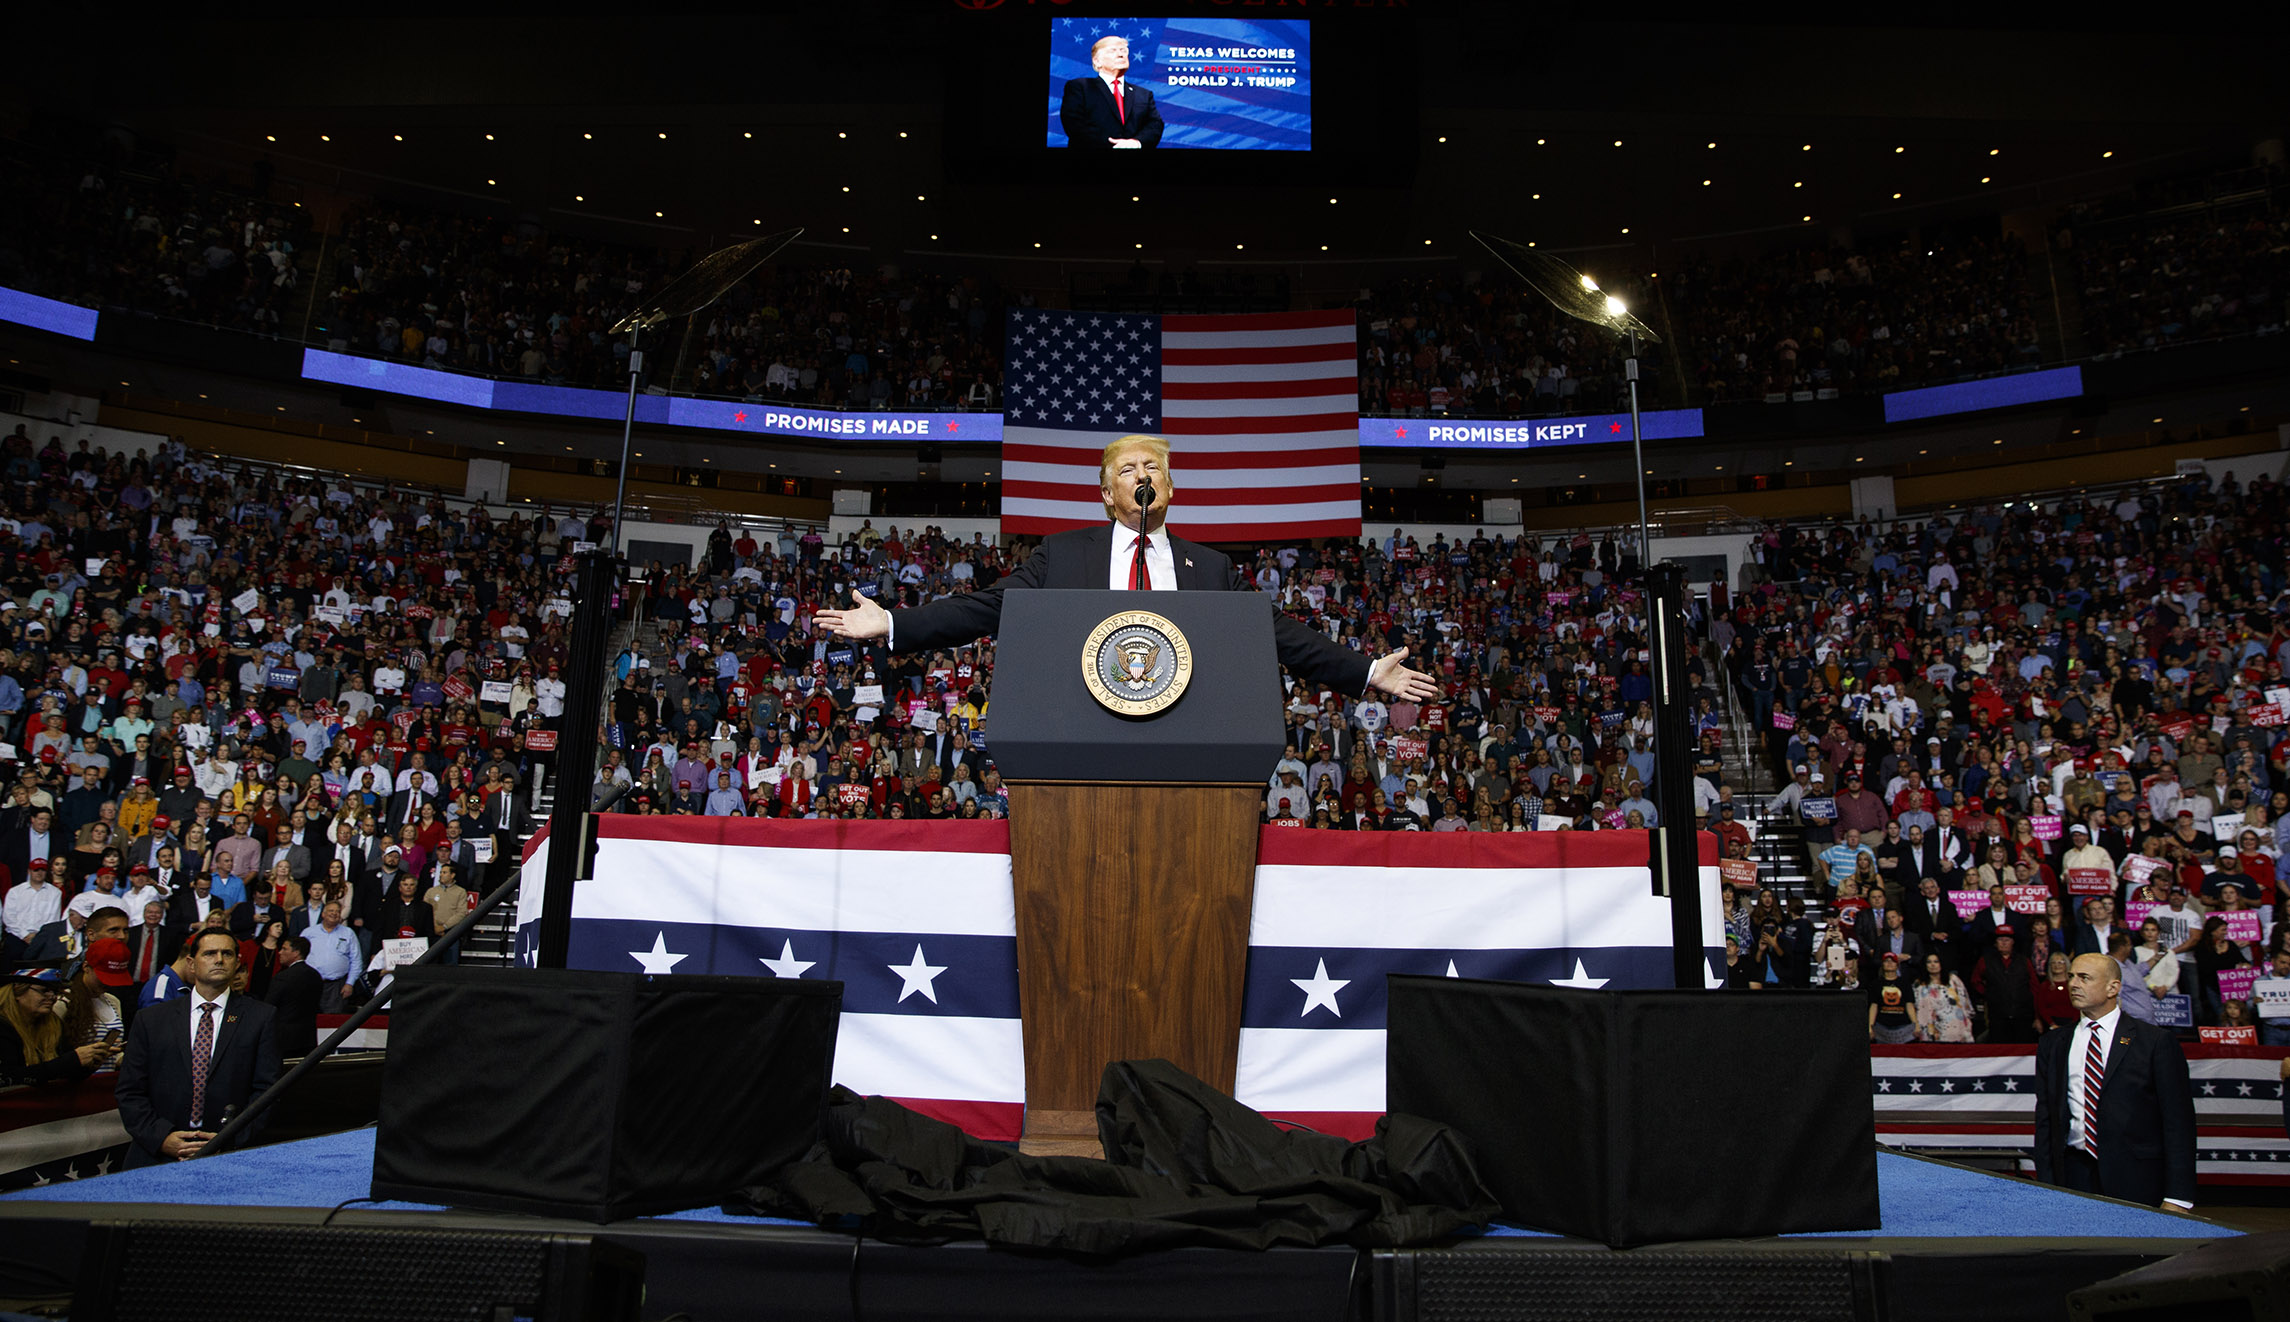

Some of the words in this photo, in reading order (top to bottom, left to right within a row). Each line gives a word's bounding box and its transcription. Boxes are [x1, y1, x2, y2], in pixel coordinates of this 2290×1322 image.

[1169, 47, 1213, 59] TEXAS
[1217, 47, 1295, 60] WELCOMES
[1204, 66, 1261, 74] PRESIDENT
[1168, 75, 1228, 87] DONALD
[1231, 76, 1243, 88] J.
[1247, 75, 1296, 88] TRUMP
[765, 413, 866, 434] PROMISES
[872, 419, 930, 435] MADE
[1429, 427, 1529, 443] PROMISES
[1536, 423, 1588, 441] KEPT
[1139, 615, 1150, 623] OF
[1151, 619, 1165, 629] THE
[1086, 614, 1137, 659] PRESIDENT
[1167, 628, 1189, 671] UNITED
[957, 664, 972, 677] 99
[1086, 662, 1094, 677] THE
[1098, 688, 1126, 710] SEAL
[1145, 679, 1183, 710] STATES
[2251, 714, 2281, 726] VOTE
[1399, 750, 1424, 758] VOTE
[840, 795, 866, 803] VOTE
[2030, 816, 2061, 825] OMEN
[2004, 887, 2023, 895] GET
[2025, 887, 2047, 895] OUT
[2008, 901, 2046, 912] VOTE
[2225, 931, 2257, 939] UMP
[388, 946, 426, 954] AMERICAN
[2218, 969, 2261, 980] WOMEN
[2222, 991, 2250, 1001] TRU
[2201, 1029, 2225, 1039] GET
[2227, 1028, 2253, 1039] OUT
